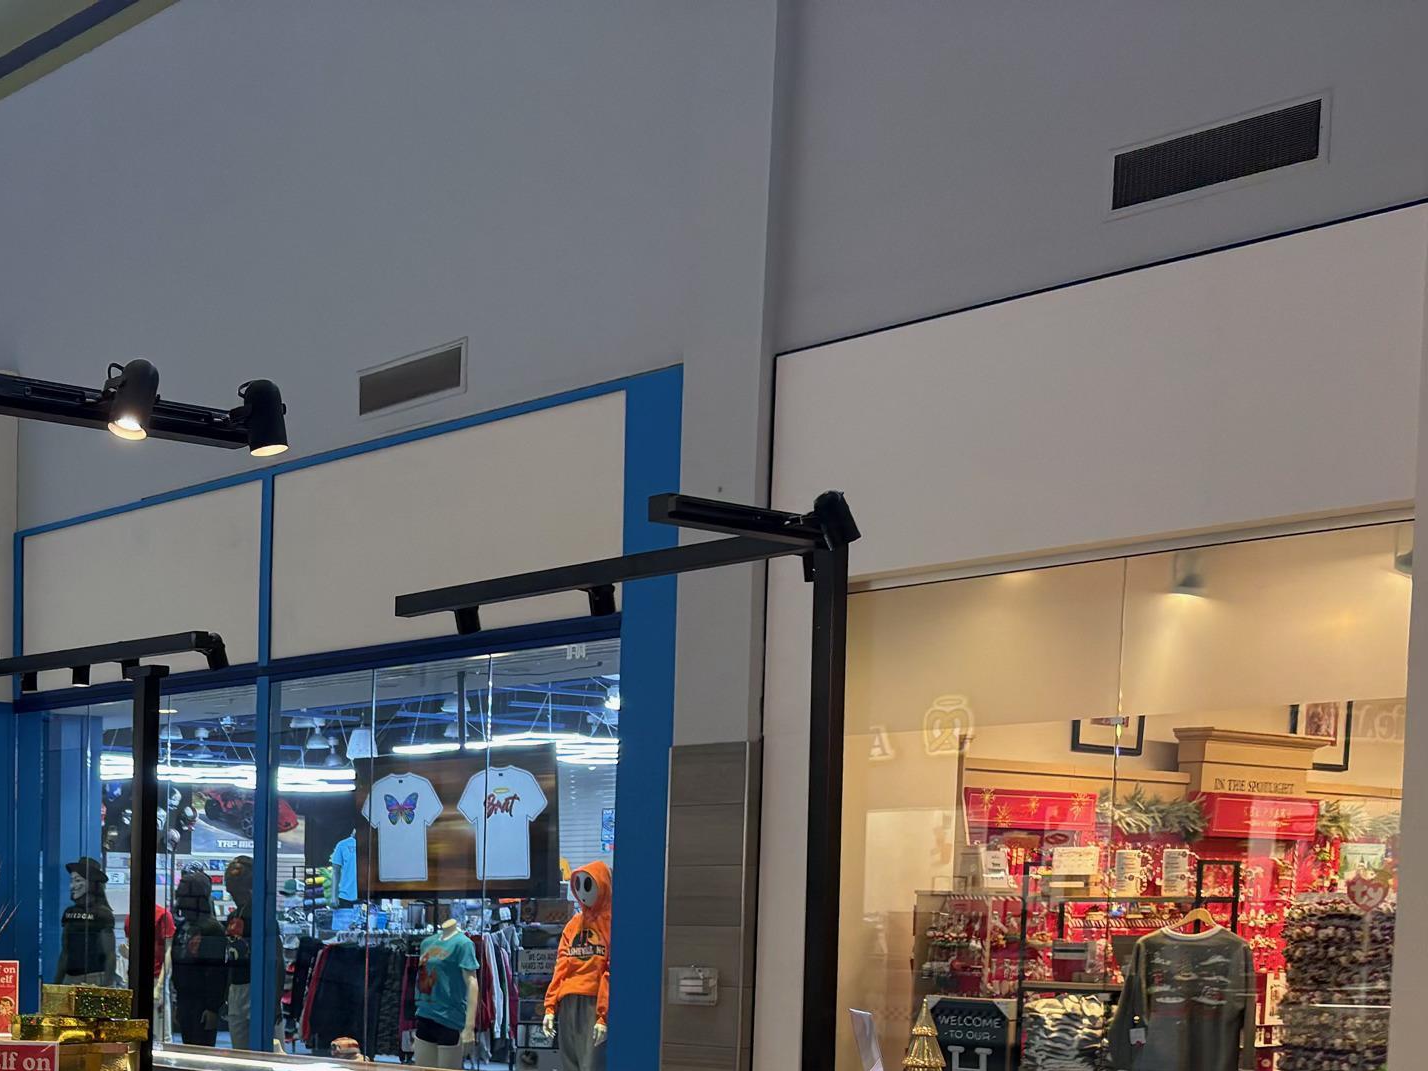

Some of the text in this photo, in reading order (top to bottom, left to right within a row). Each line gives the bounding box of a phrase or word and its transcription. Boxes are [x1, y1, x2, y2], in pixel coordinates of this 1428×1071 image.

[1214, 778, 1294, 794] IN THE SPOTLIGHT
[938, 1015, 1002, 1029] WELCOME
[22, 1057, 52, 1071] on
